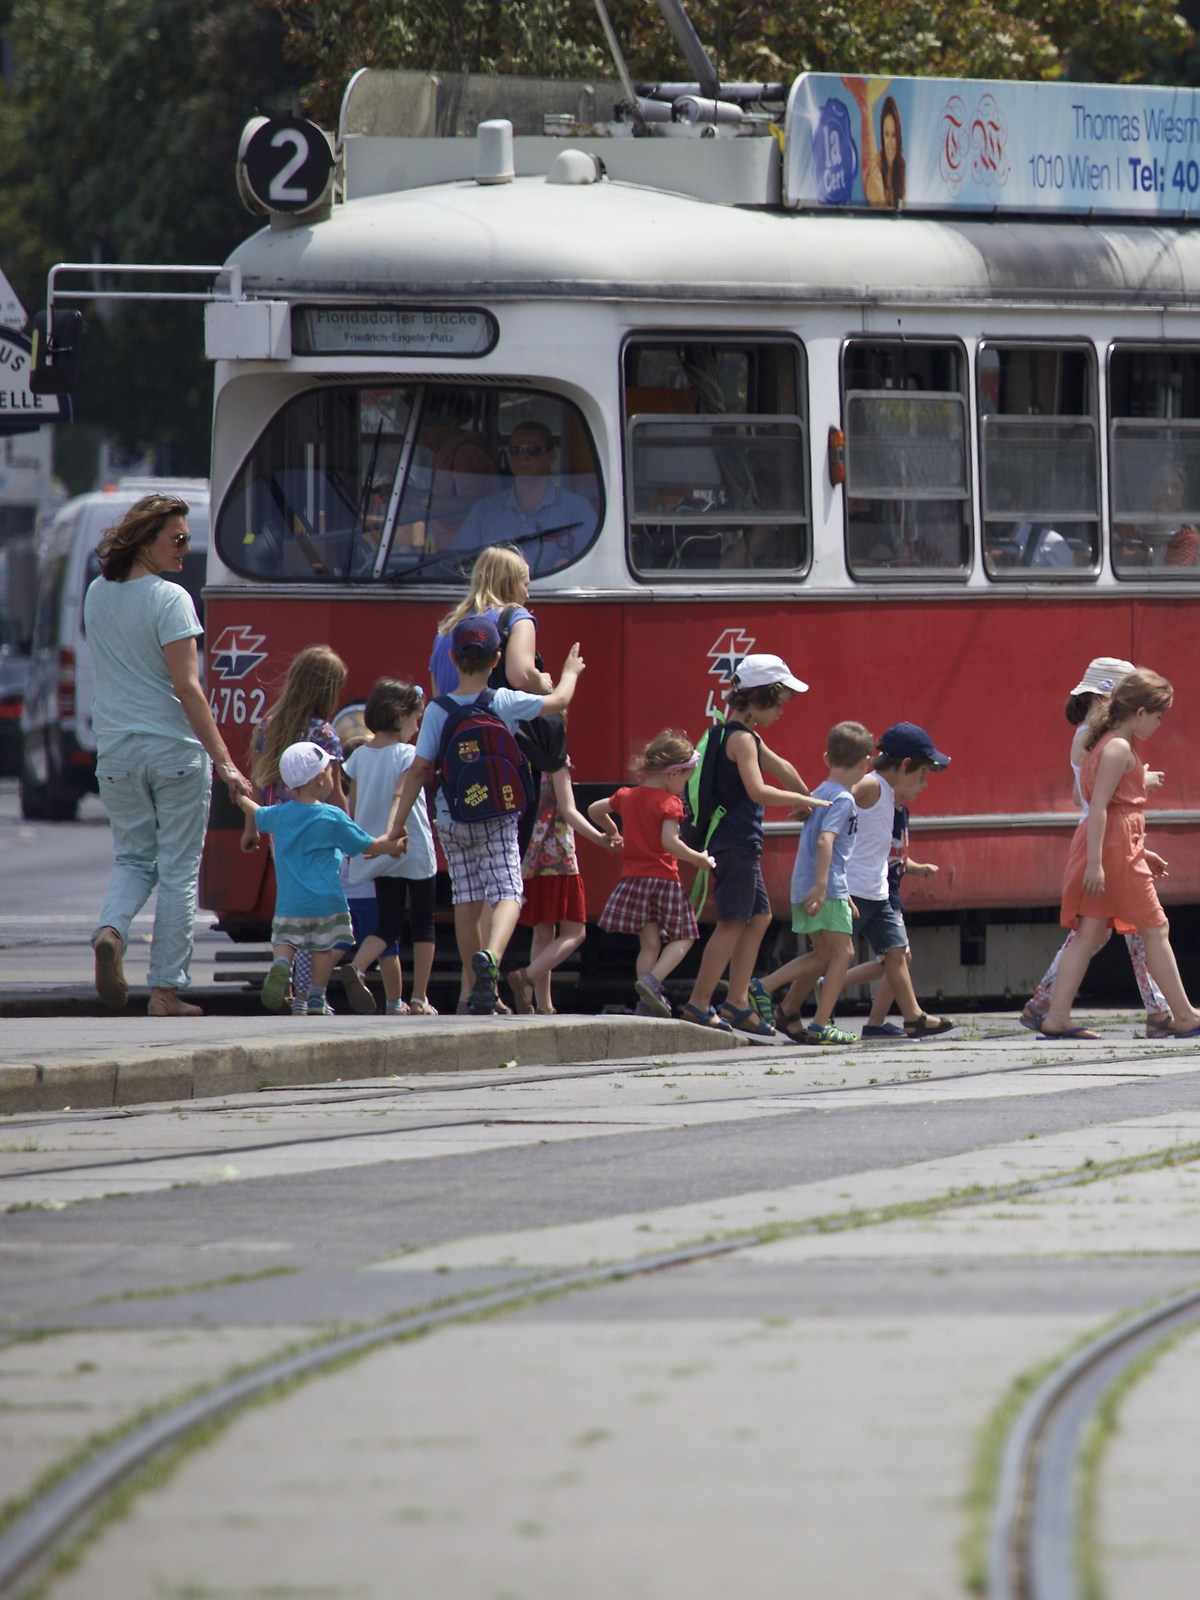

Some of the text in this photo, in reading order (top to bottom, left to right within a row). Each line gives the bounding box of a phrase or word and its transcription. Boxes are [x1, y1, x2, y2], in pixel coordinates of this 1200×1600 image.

[1072, 104, 1140, 142] Thomas
[269, 127, 309, 202] 2
[823, 125, 842, 168] 1a
[1028, 153, 1065, 189] 1010
[1067, 154, 1111, 191] Wien
[1128, 156, 1165, 194] Tel:
[209, 687, 266, 724] 4762
